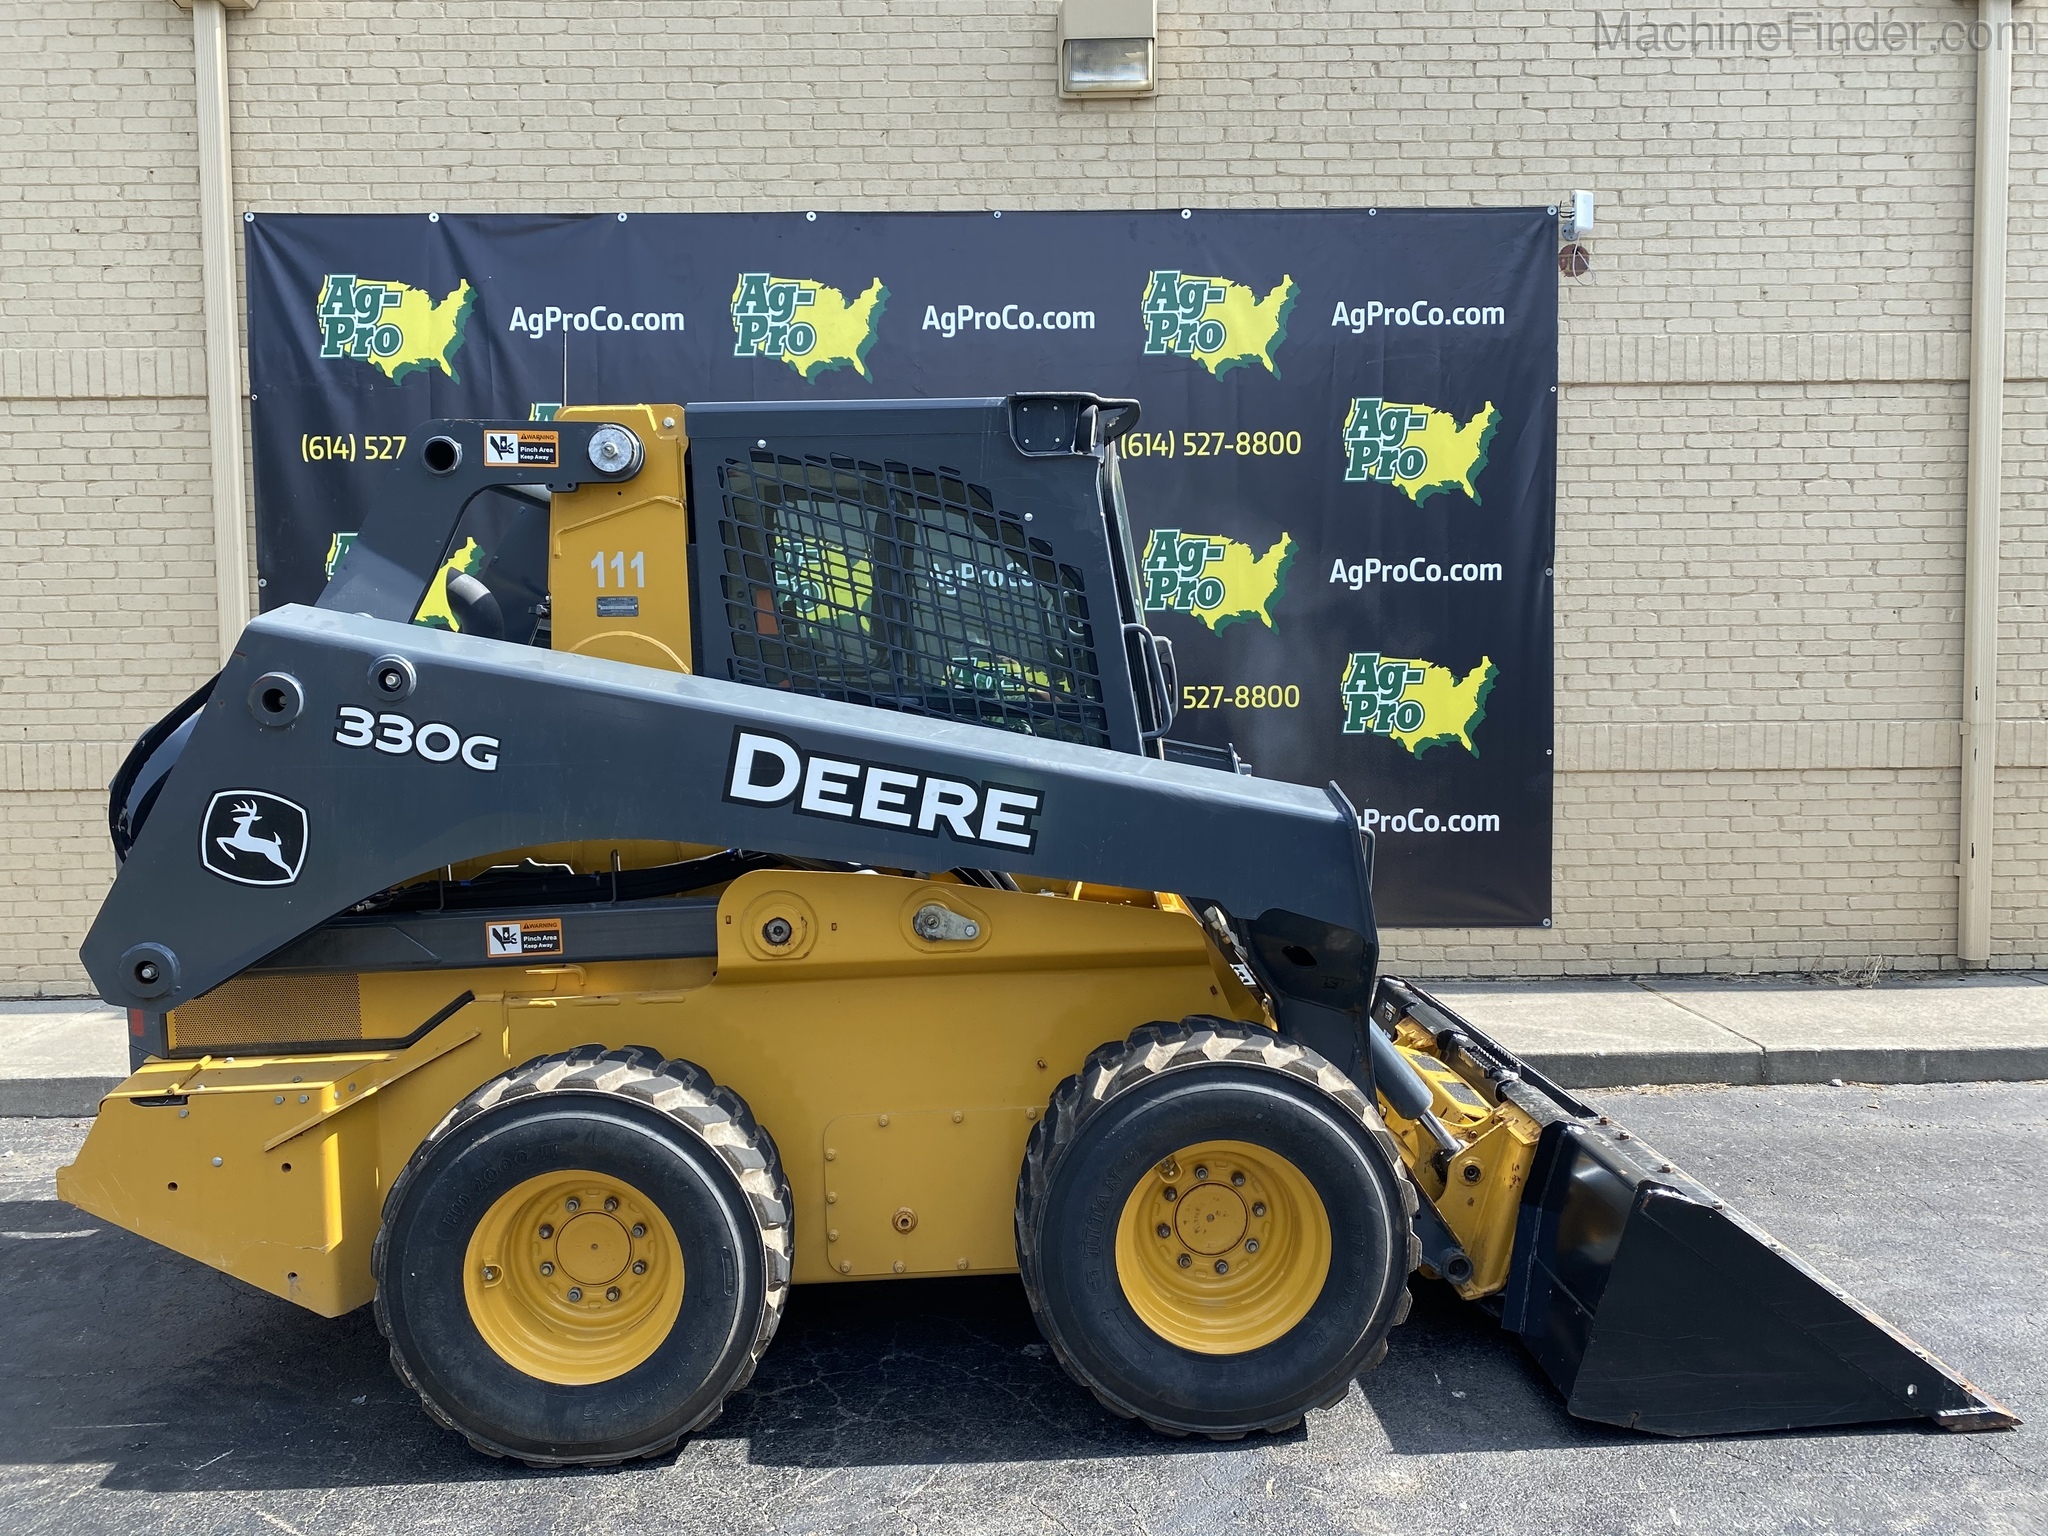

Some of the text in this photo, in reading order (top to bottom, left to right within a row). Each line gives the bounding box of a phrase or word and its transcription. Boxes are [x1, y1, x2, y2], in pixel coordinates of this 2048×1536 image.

[319, 275, 402, 326] Ag-
[733, 273, 817, 325] Ag-
[1144, 270, 1228, 322] Ag-
[1331, 300, 1505, 334] AgProCo.com
[319, 314, 403, 358] Pro
[509, 305, 685, 339] AgProCo.com
[733, 313, 817, 357] Pro
[922, 305, 1096, 338] AgProCo.com
[1144, 311, 1227, 354] Pro
[1344, 398, 1428, 447] Ag-
[301, 433, 356, 463] (614)
[1120, 430, 1303, 460] (614) 527-8800
[1344, 437, 1428, 481] Pro
[591, 551, 645, 588] 111
[1144, 529, 1226, 579] Ag-
[1329, 557, 1502, 591] AgProCo.com
[1144, 569, 1226, 612] Pro
[1183, 684, 1301, 710] 527-8800
[1342, 653, 1426, 702] Ag-
[1342, 691, 1426, 735] Pro
[335, 706, 499, 771] 330G
[730, 732, 1040, 849] DEERE
[1357, 808, 1500, 833] ProCo.com
